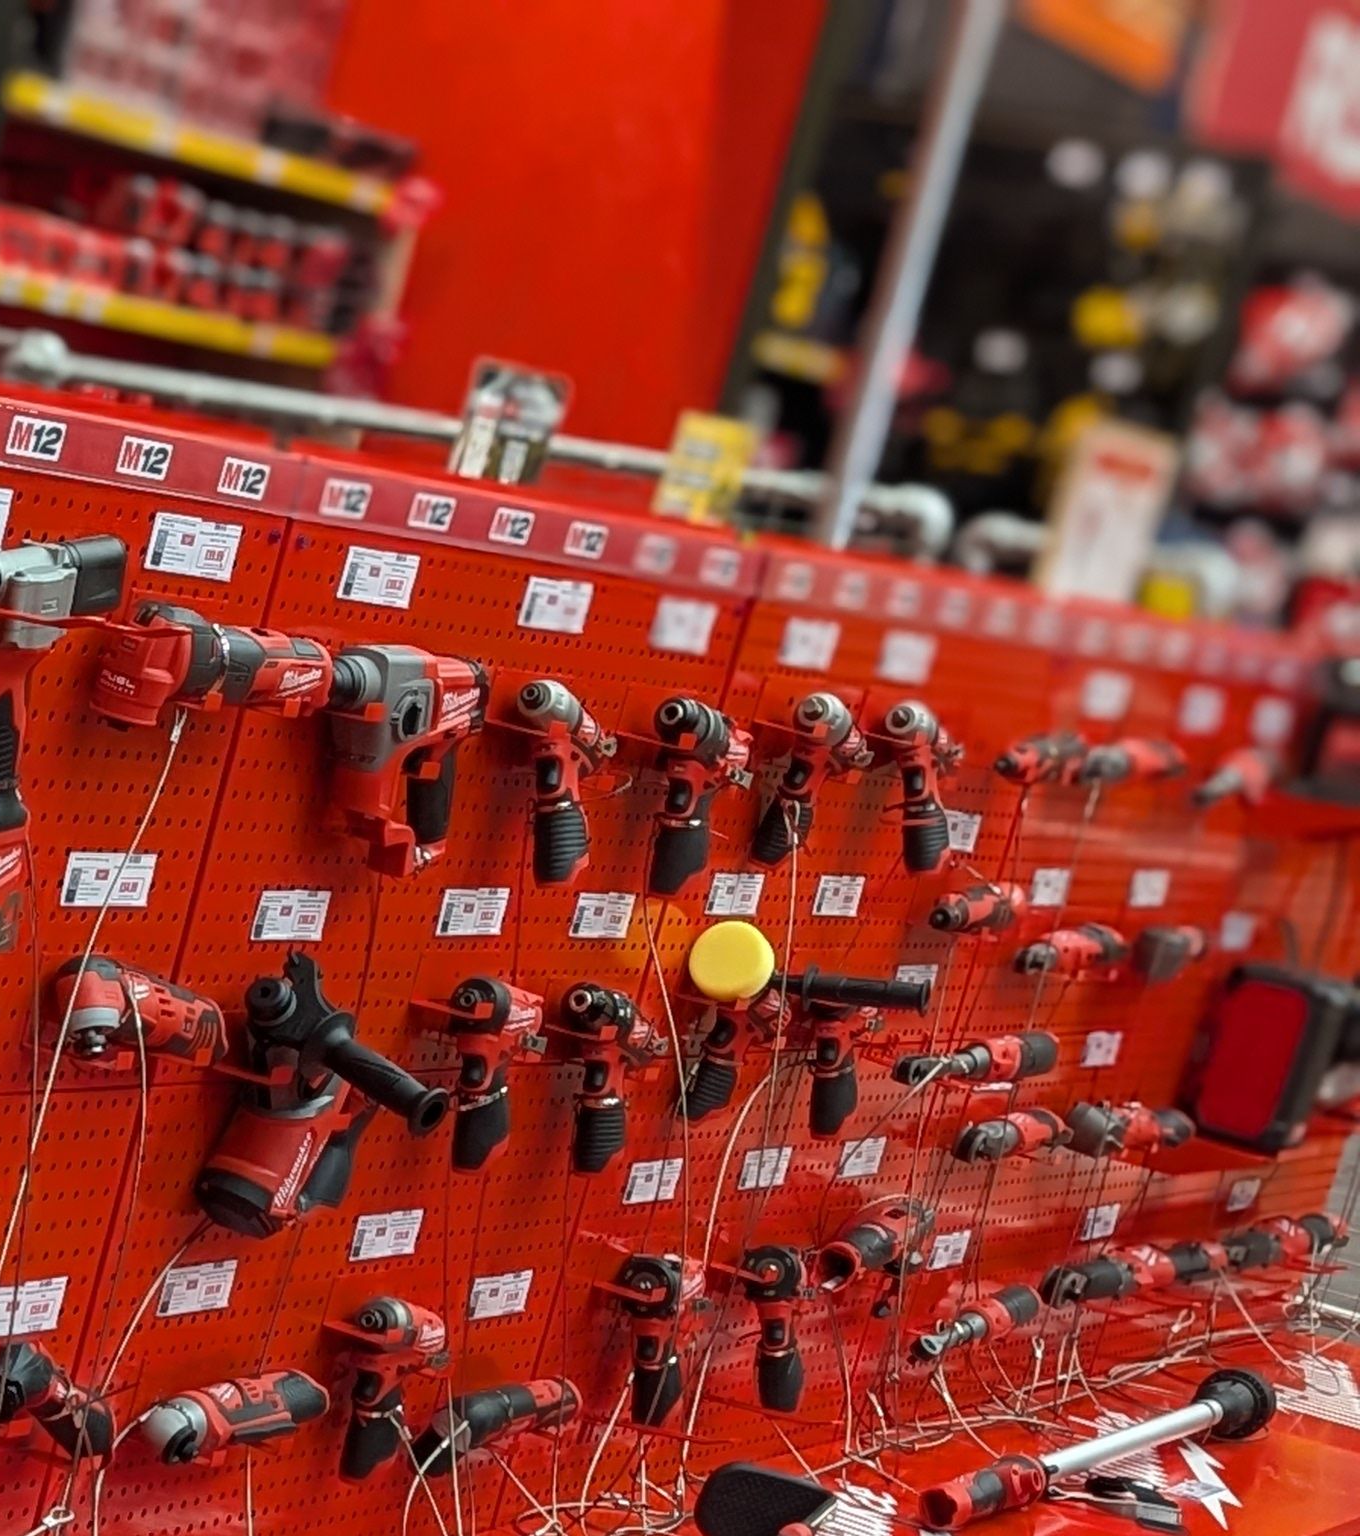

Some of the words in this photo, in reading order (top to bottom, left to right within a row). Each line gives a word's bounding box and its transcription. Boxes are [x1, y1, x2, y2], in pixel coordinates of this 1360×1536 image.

[12, 421, 62, 458] M12
[121, 443, 168, 476] M12
[222, 463, 265, 494] M12
[412, 499, 452, 527] M12
